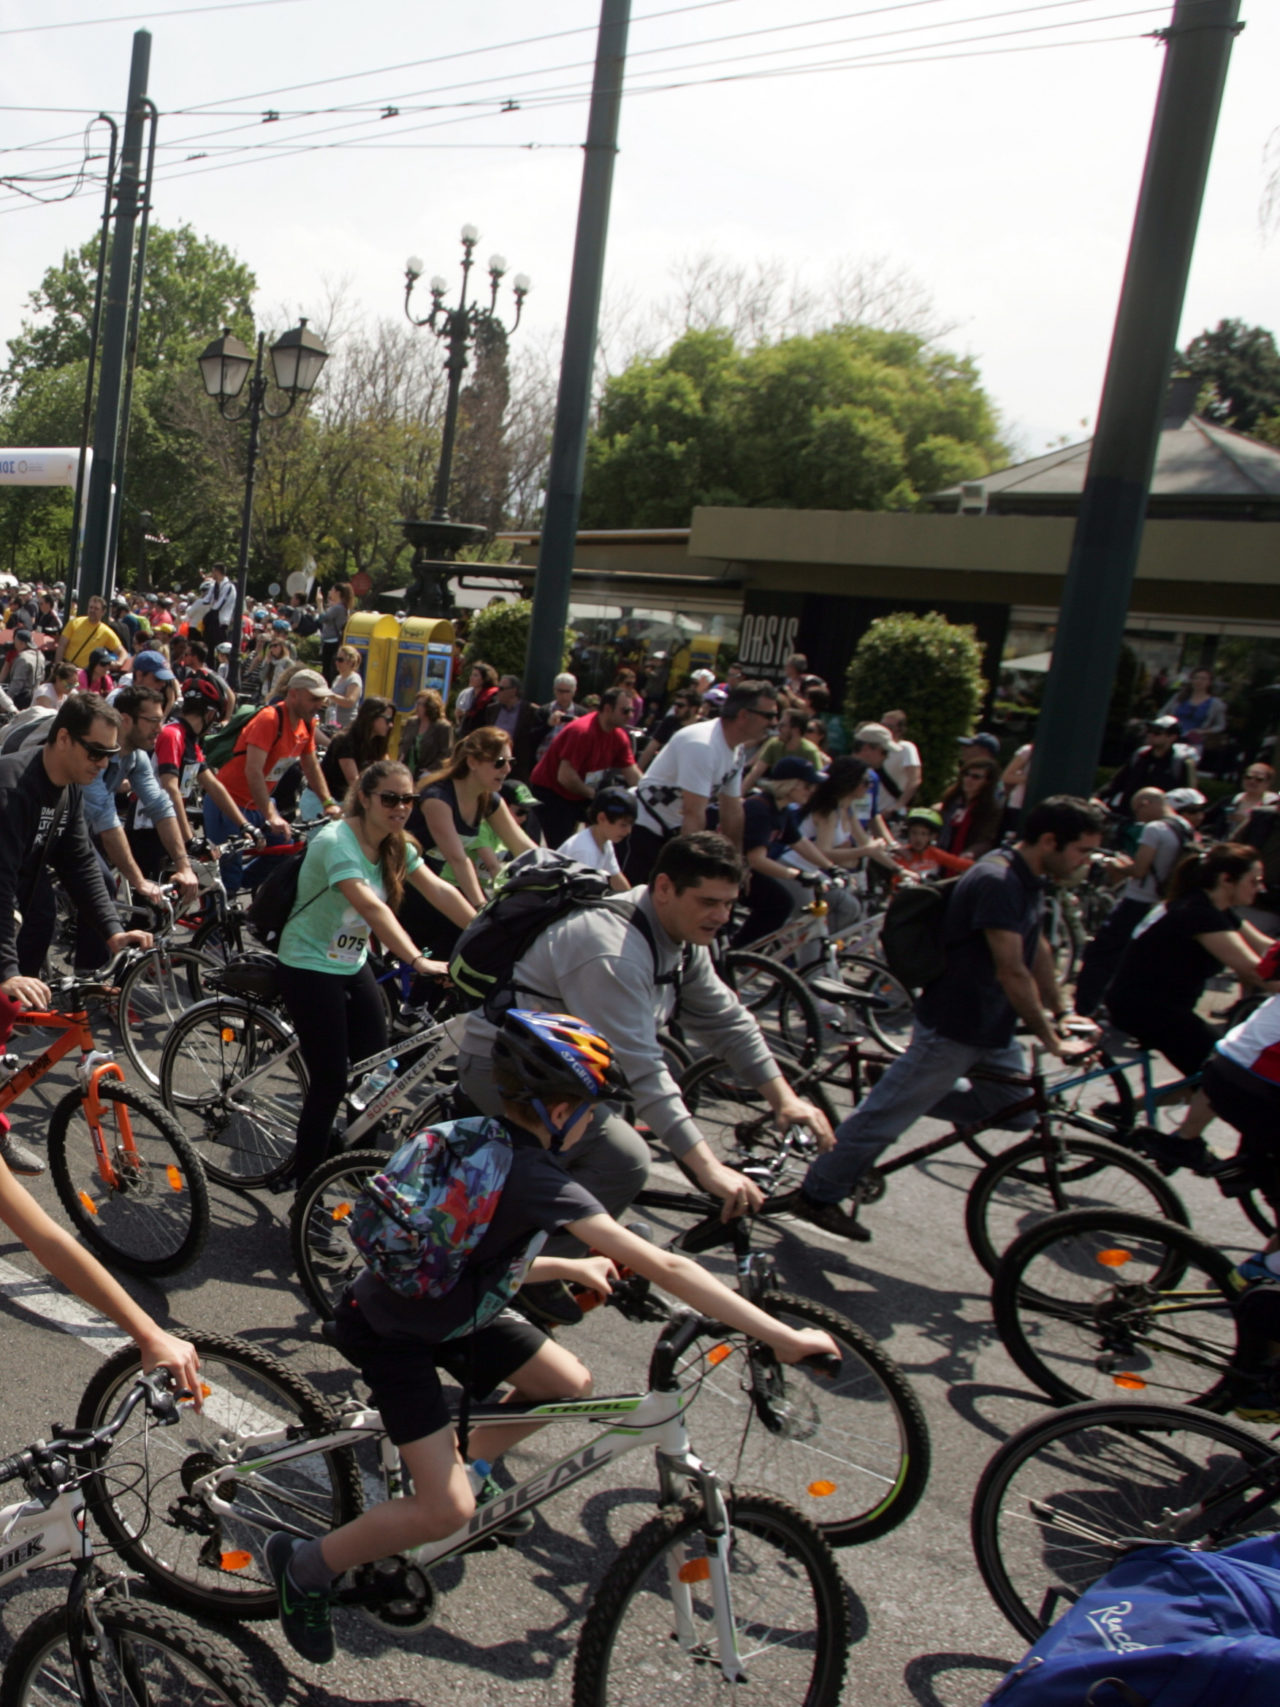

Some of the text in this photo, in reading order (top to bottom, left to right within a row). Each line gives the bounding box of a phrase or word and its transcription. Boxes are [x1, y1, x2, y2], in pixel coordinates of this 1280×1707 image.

[739, 614, 799, 665] OASIS
[547, 1402, 632, 1413] TRIAL
[469, 1447, 613, 1534] IDEAL
